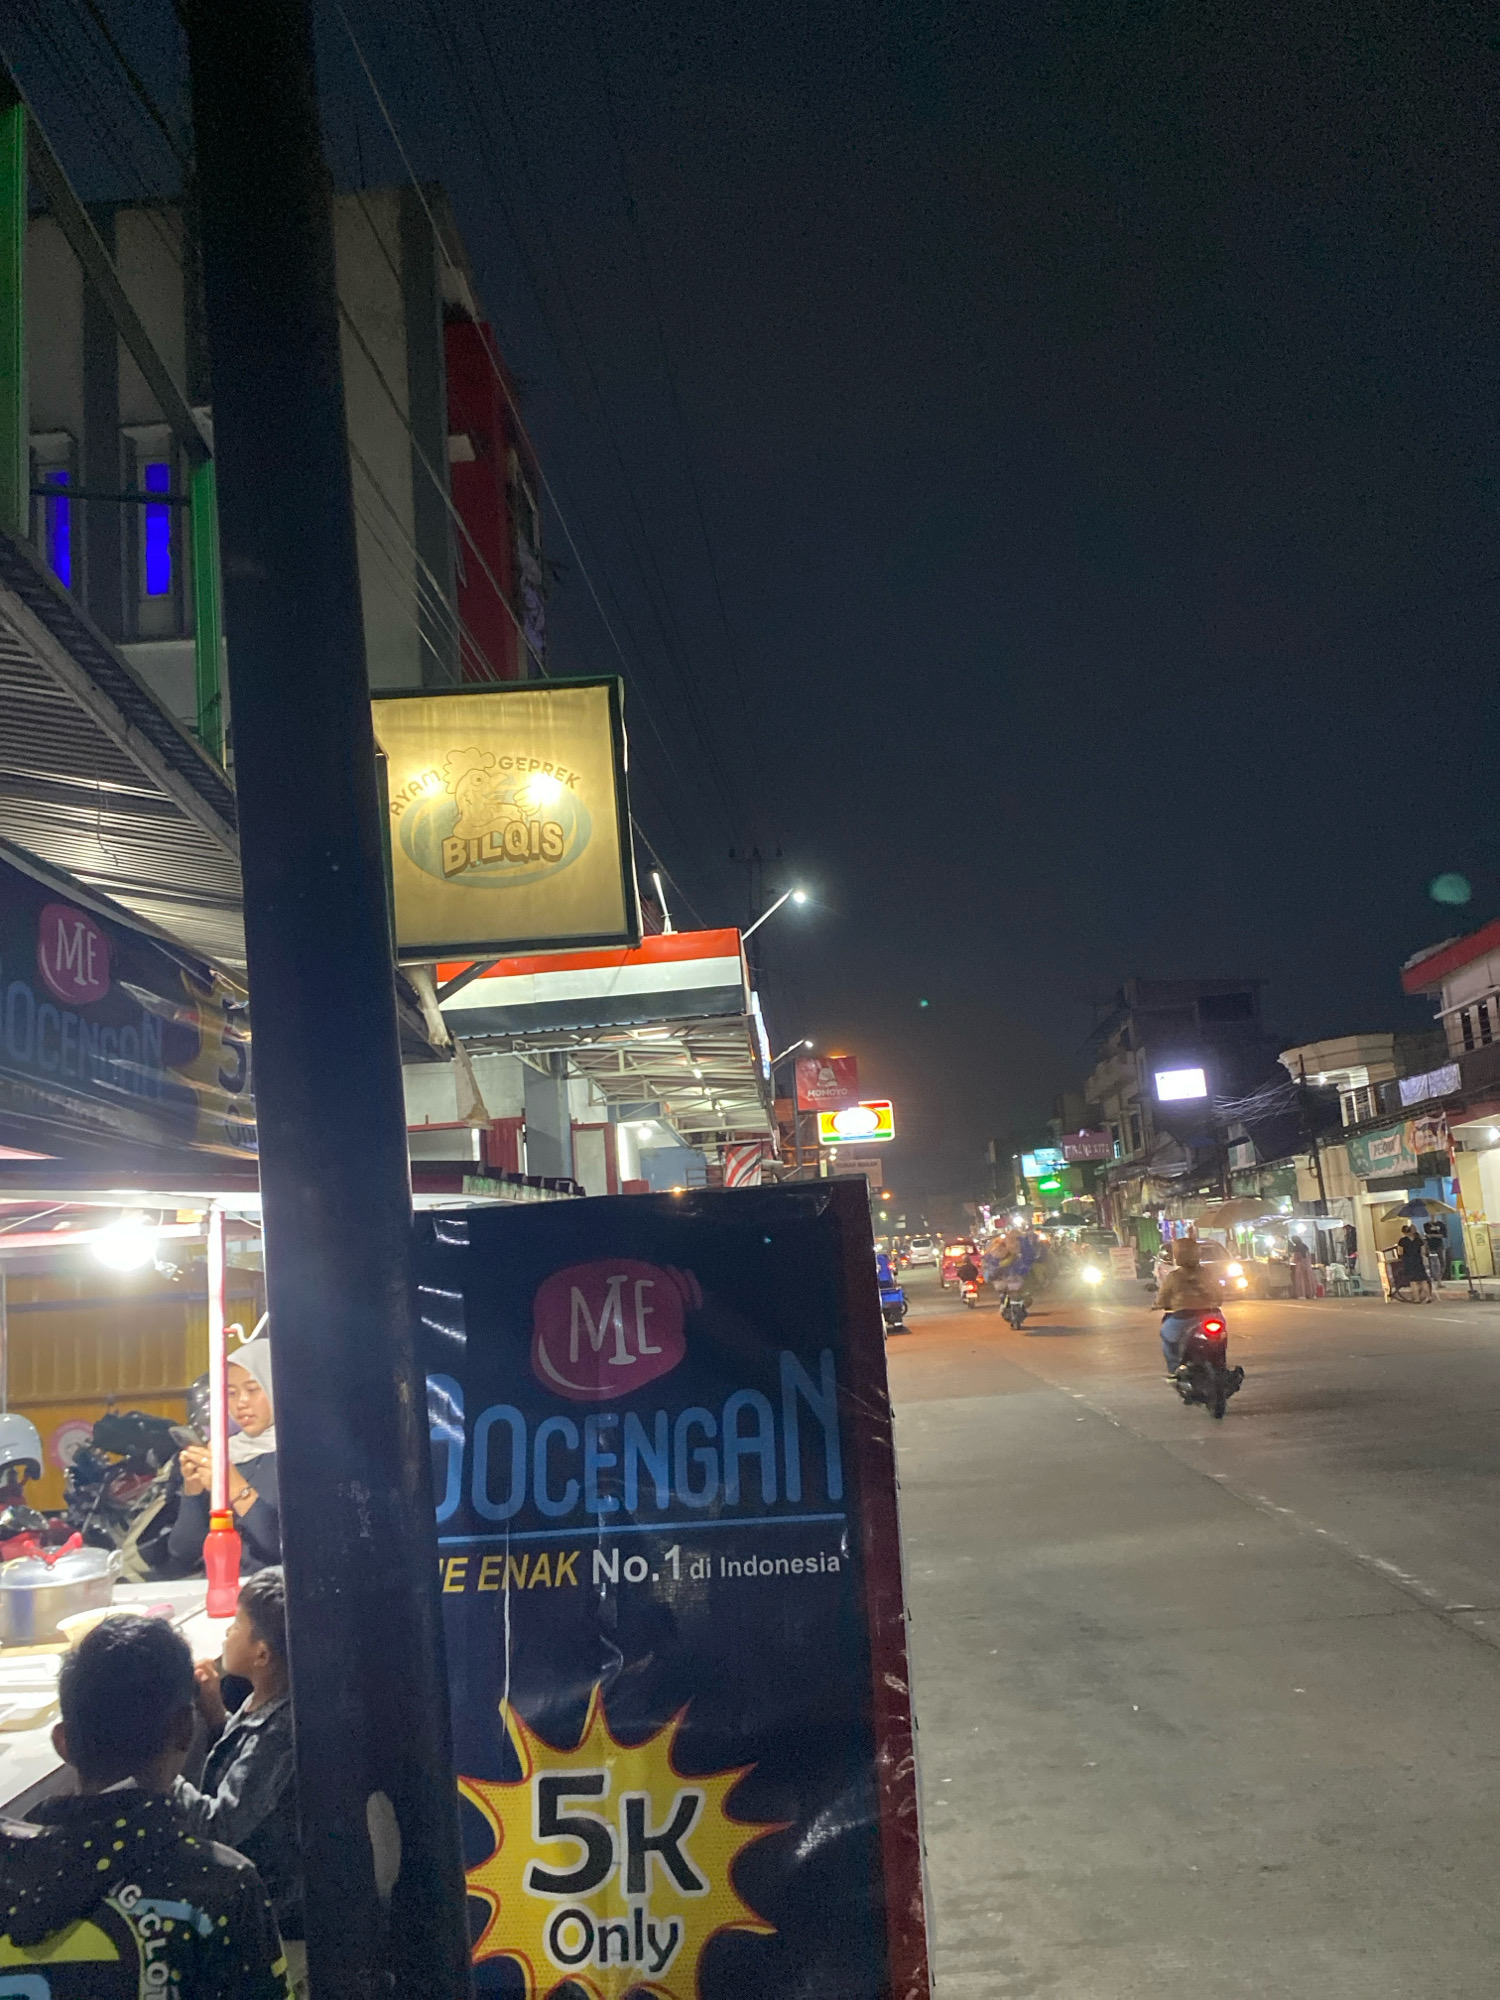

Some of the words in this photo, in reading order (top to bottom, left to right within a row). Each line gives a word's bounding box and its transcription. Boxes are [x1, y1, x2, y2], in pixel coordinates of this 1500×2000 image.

[390, 768, 442, 817] AYAM
[499, 756, 582, 790] GEPREK
[442, 820, 565, 879] BILQIS
[0, 980, 164, 1098] OCENGAN
[807, 1088, 848, 1098] MOMOYO
[477, 1551, 581, 1592] ENAK
[592, 1544, 680, 1585] No.1
[690, 1558, 711, 1581] di
[720, 1552, 841, 1578] Indonesia
[528, 1772, 705, 1896] 5K
[549, 1907, 679, 1973] Only
